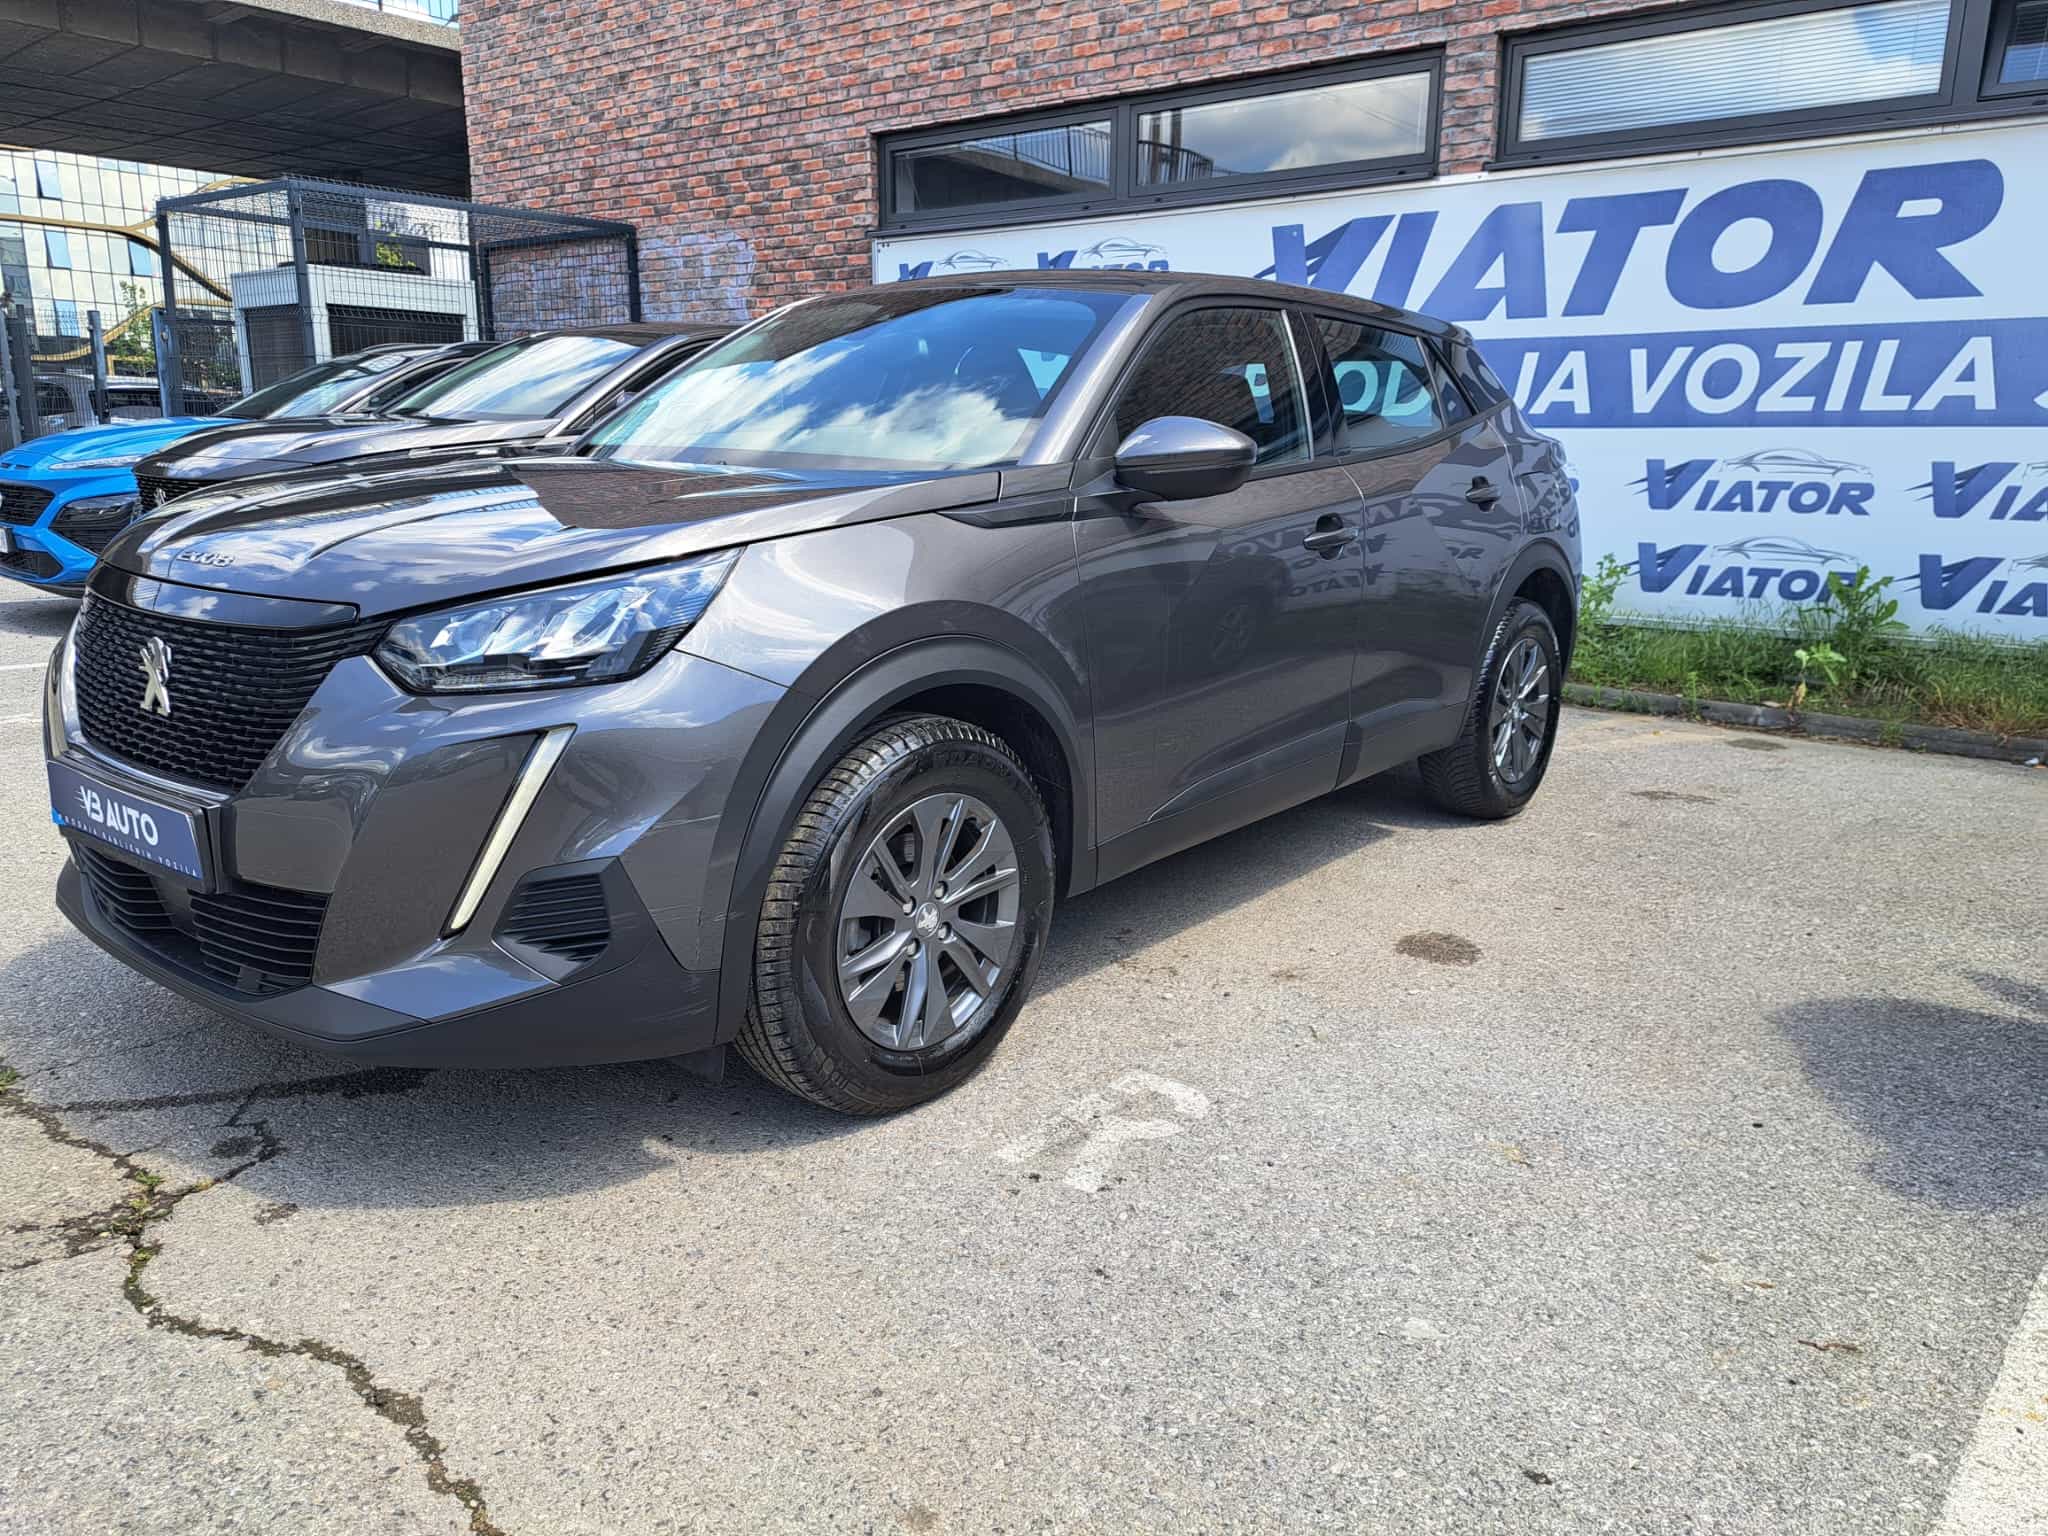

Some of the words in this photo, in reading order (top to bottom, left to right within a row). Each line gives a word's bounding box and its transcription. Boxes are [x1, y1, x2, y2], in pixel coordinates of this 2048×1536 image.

[1272, 159, 2004, 321] VIATOR
[1629, 336, 1997, 415] VOZILA
[1646, 458, 1875, 516] VIATOR
[106, 799, 158, 846] AUTO
